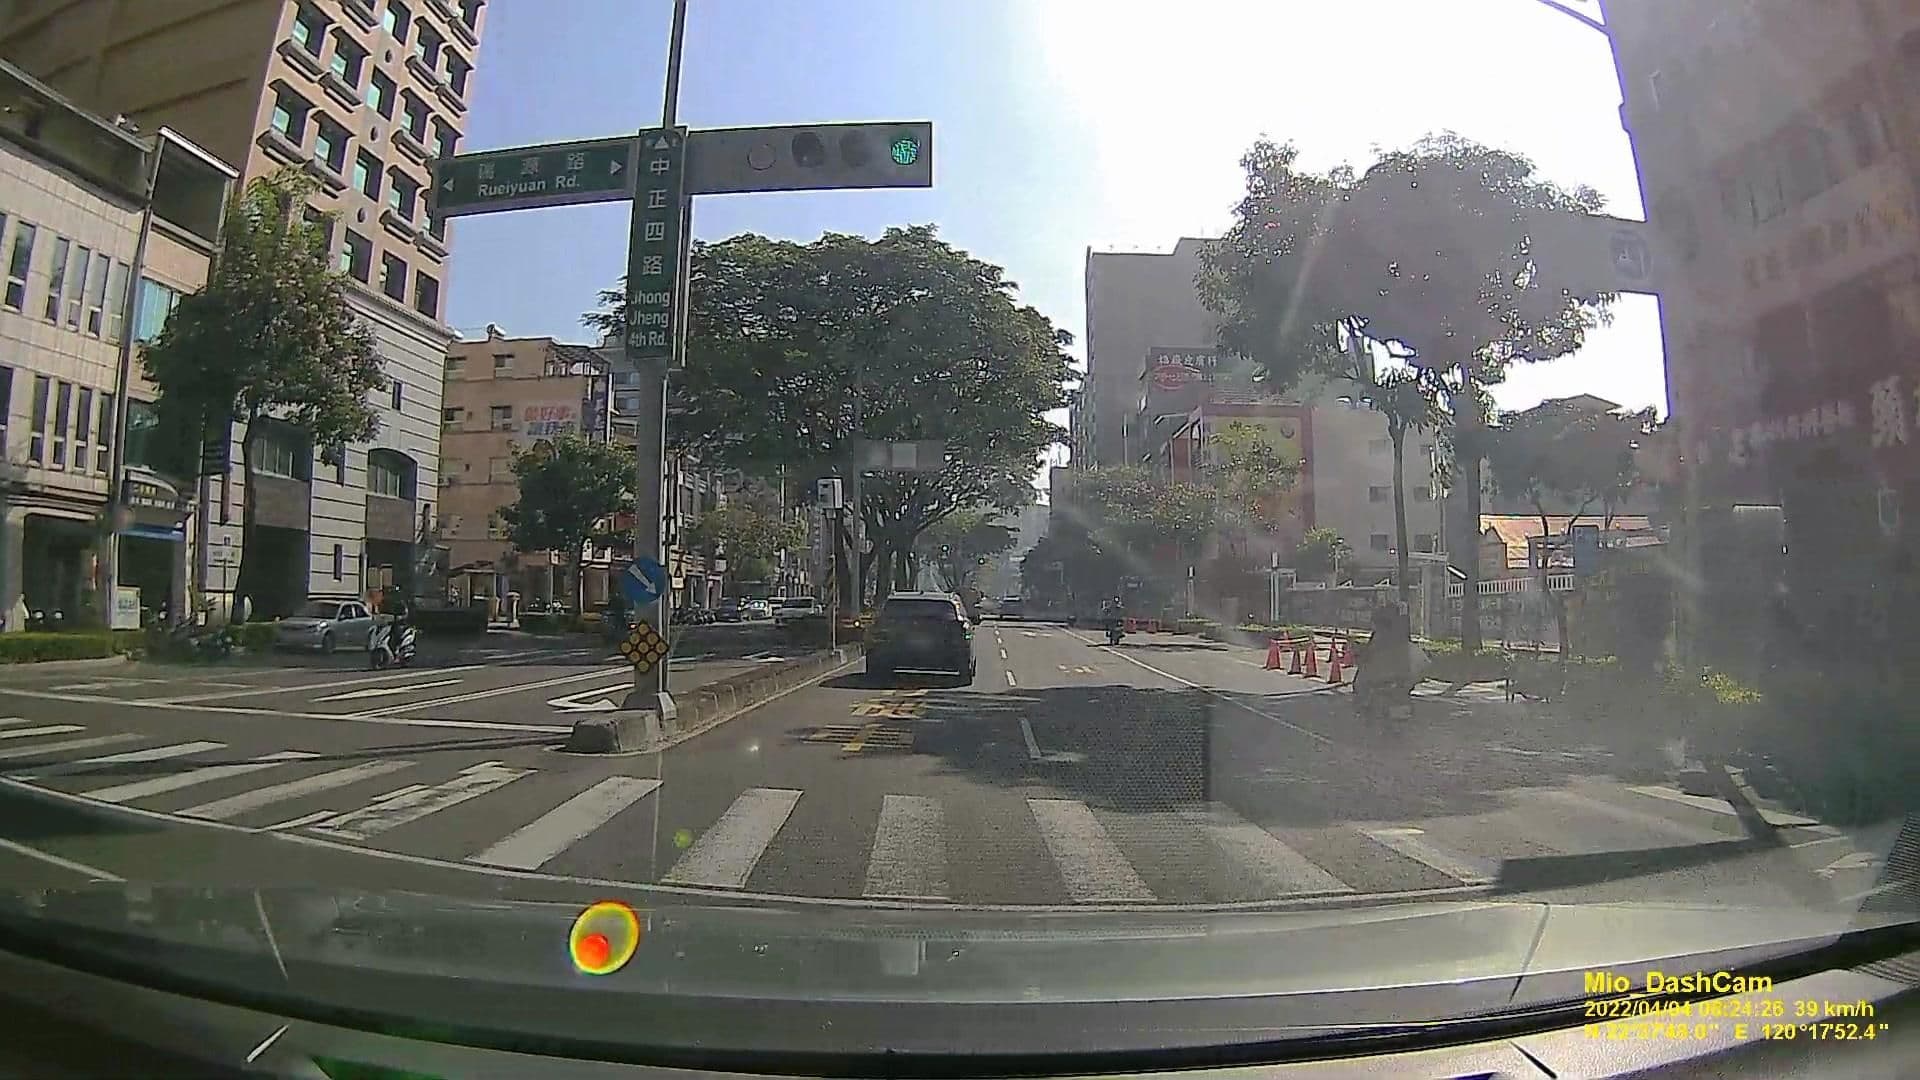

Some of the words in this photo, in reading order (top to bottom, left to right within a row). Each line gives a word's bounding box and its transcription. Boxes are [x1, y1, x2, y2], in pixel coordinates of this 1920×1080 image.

[478, 178, 547, 198] Rueiyuan
[556, 174, 581, 190] Rd.
[642, 157, 671, 277] 中正四路
[630, 310, 670, 328] Jheng
[629, 330, 646, 348] 4th
[648, 330, 668, 346] Rd.
